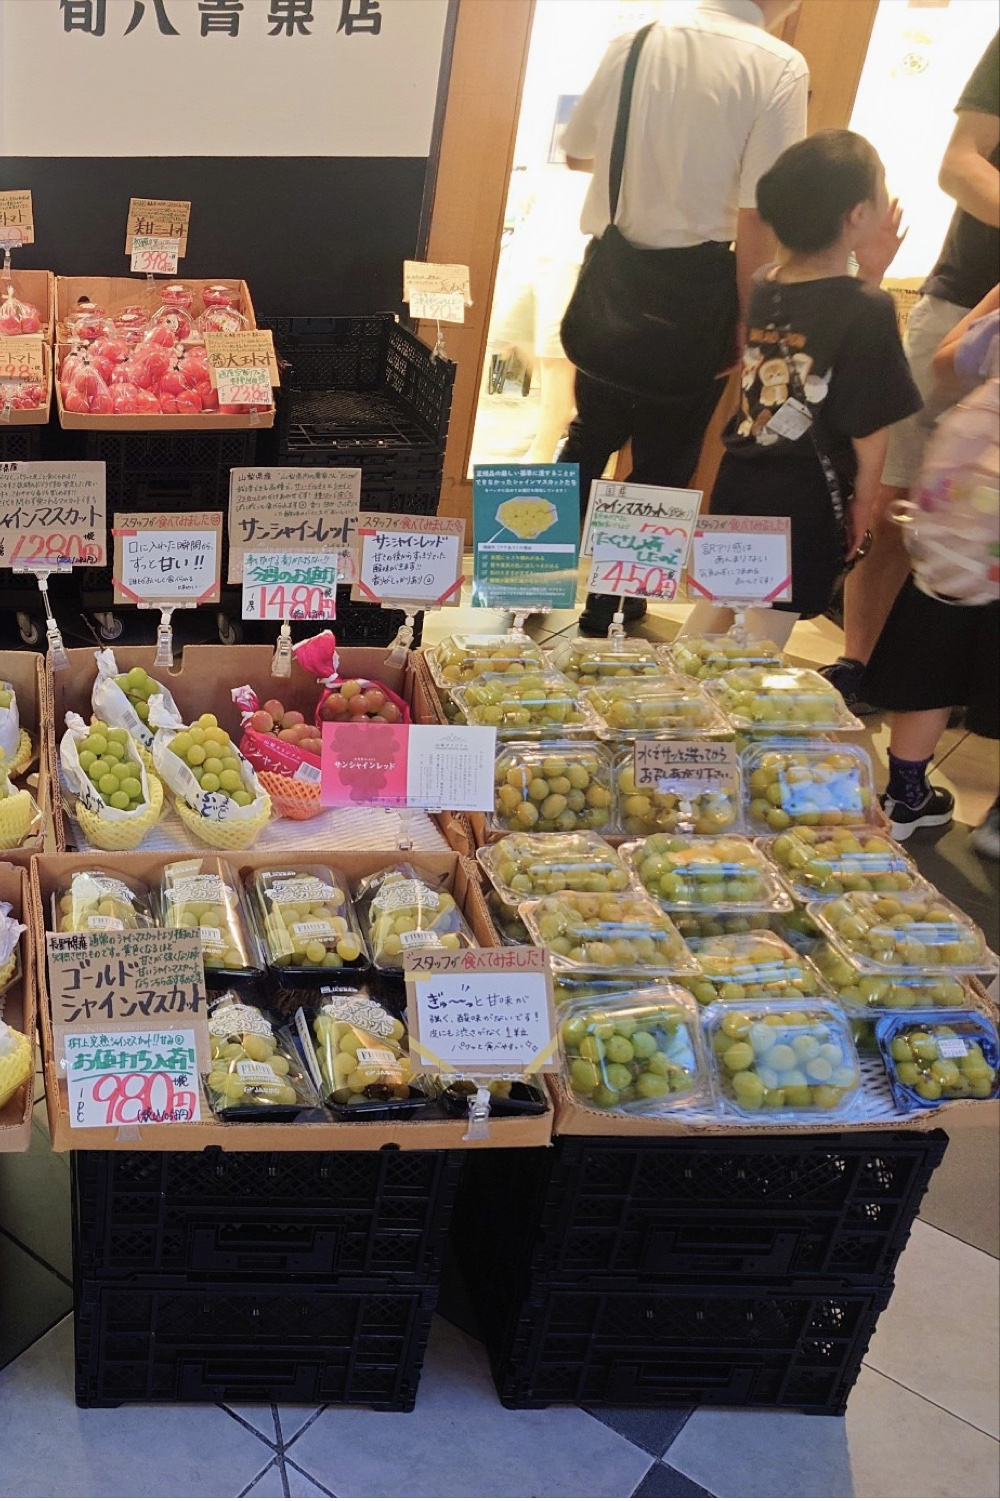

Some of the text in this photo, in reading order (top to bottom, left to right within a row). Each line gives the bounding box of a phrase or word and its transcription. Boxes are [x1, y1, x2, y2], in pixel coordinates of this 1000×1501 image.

[595, 498, 669, 518] シャインマスカット
[238, 517, 359, 543] サンシャインレッド
[371, 533, 449, 550] サンシャインレッド
[129, 554, 205, 573] ずっと甘い!!
[333, 760, 396, 770] サンシャインレッド
[411, 949, 546, 971] スタッフが食べてみました!
[60, 959, 140, 991] ゴールド
[60, 982, 206, 1023] シャインマスカット
[92, 1072, 197, 1125] 980円
